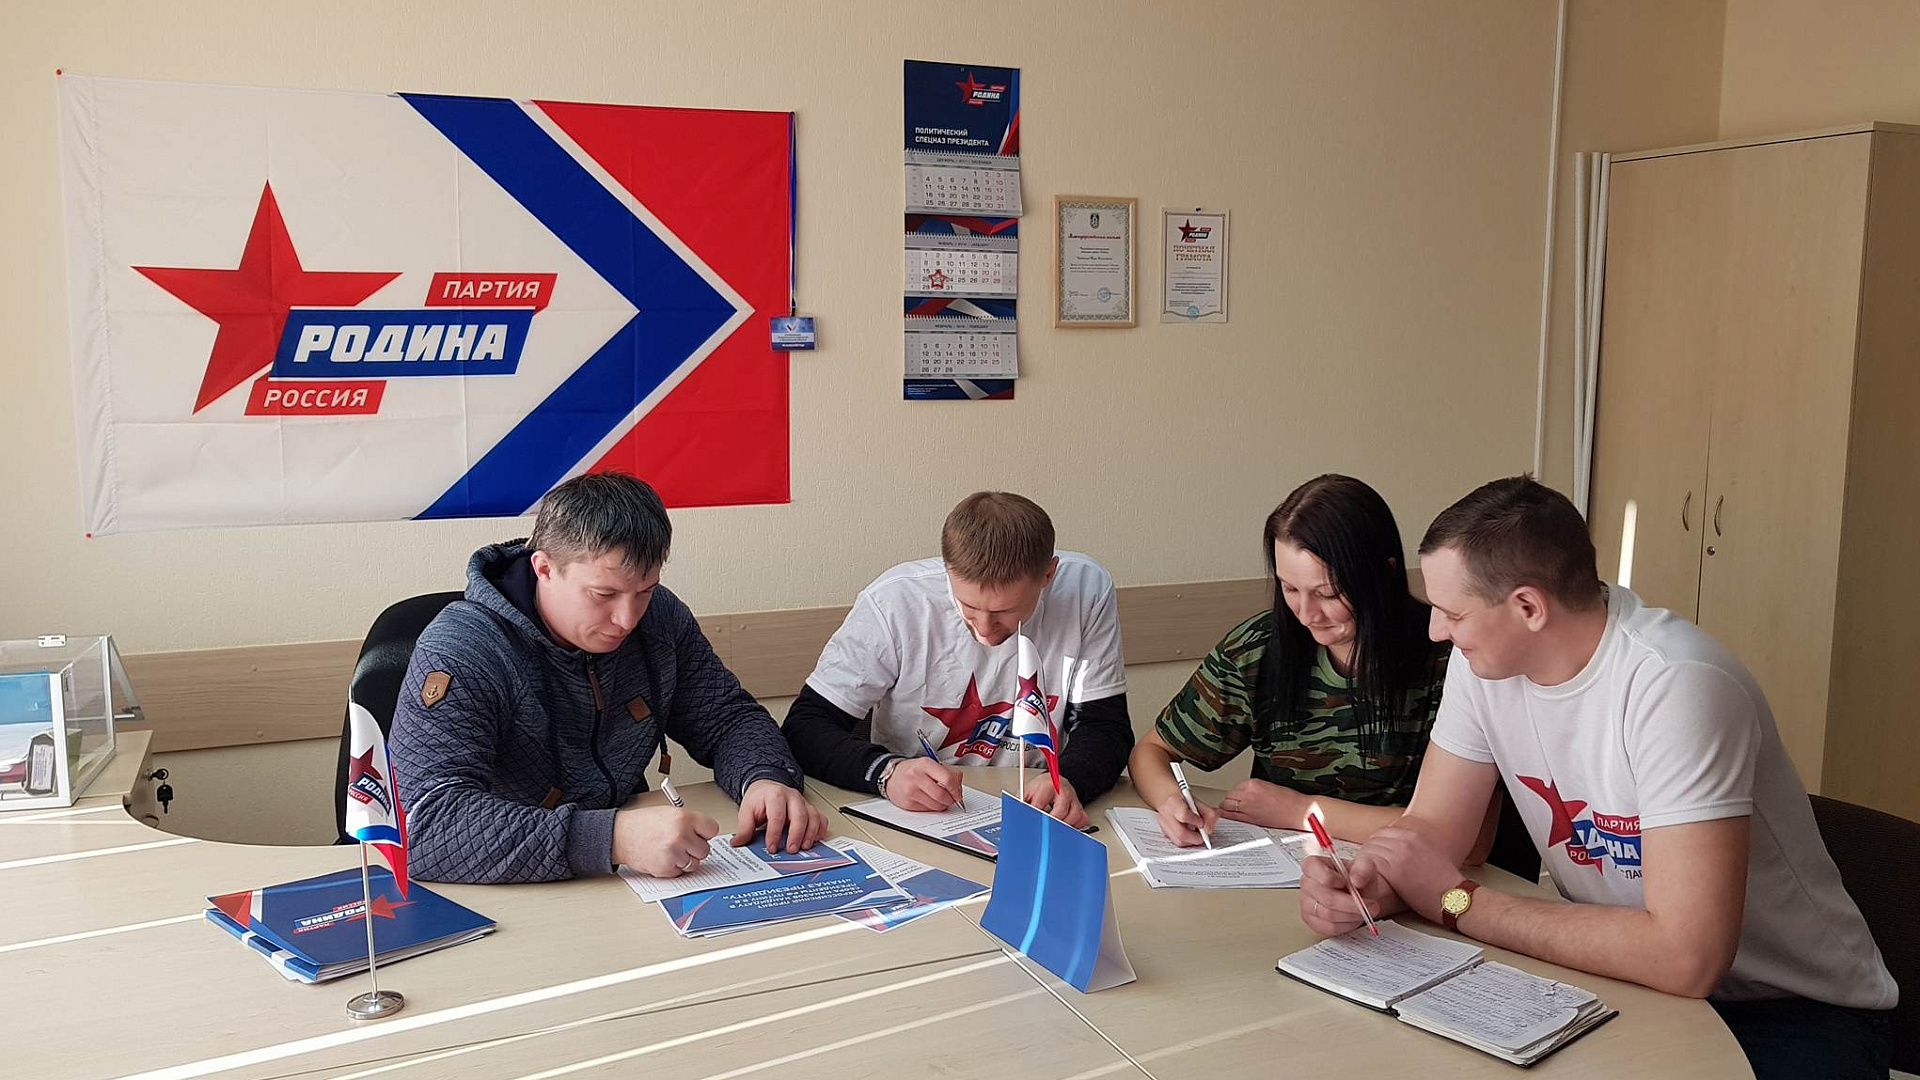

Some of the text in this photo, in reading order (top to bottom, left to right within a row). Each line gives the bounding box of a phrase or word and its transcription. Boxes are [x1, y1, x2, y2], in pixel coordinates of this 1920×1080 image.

[915, 127, 968, 137] ПОЛИТИЧЕСКИЙ
[915, 136, 989, 147] СПЕЦНАЗ ПРЕЗИДЕНТА
[443, 281, 541, 298] ПАРТИЯ
[293, 324, 508, 363] РОДИНА
[264, 389, 368, 408] РОССИЯ
[1597, 817, 1640, 831] ПАРТИЯ
[301, 906, 366, 926] РОДИНА
